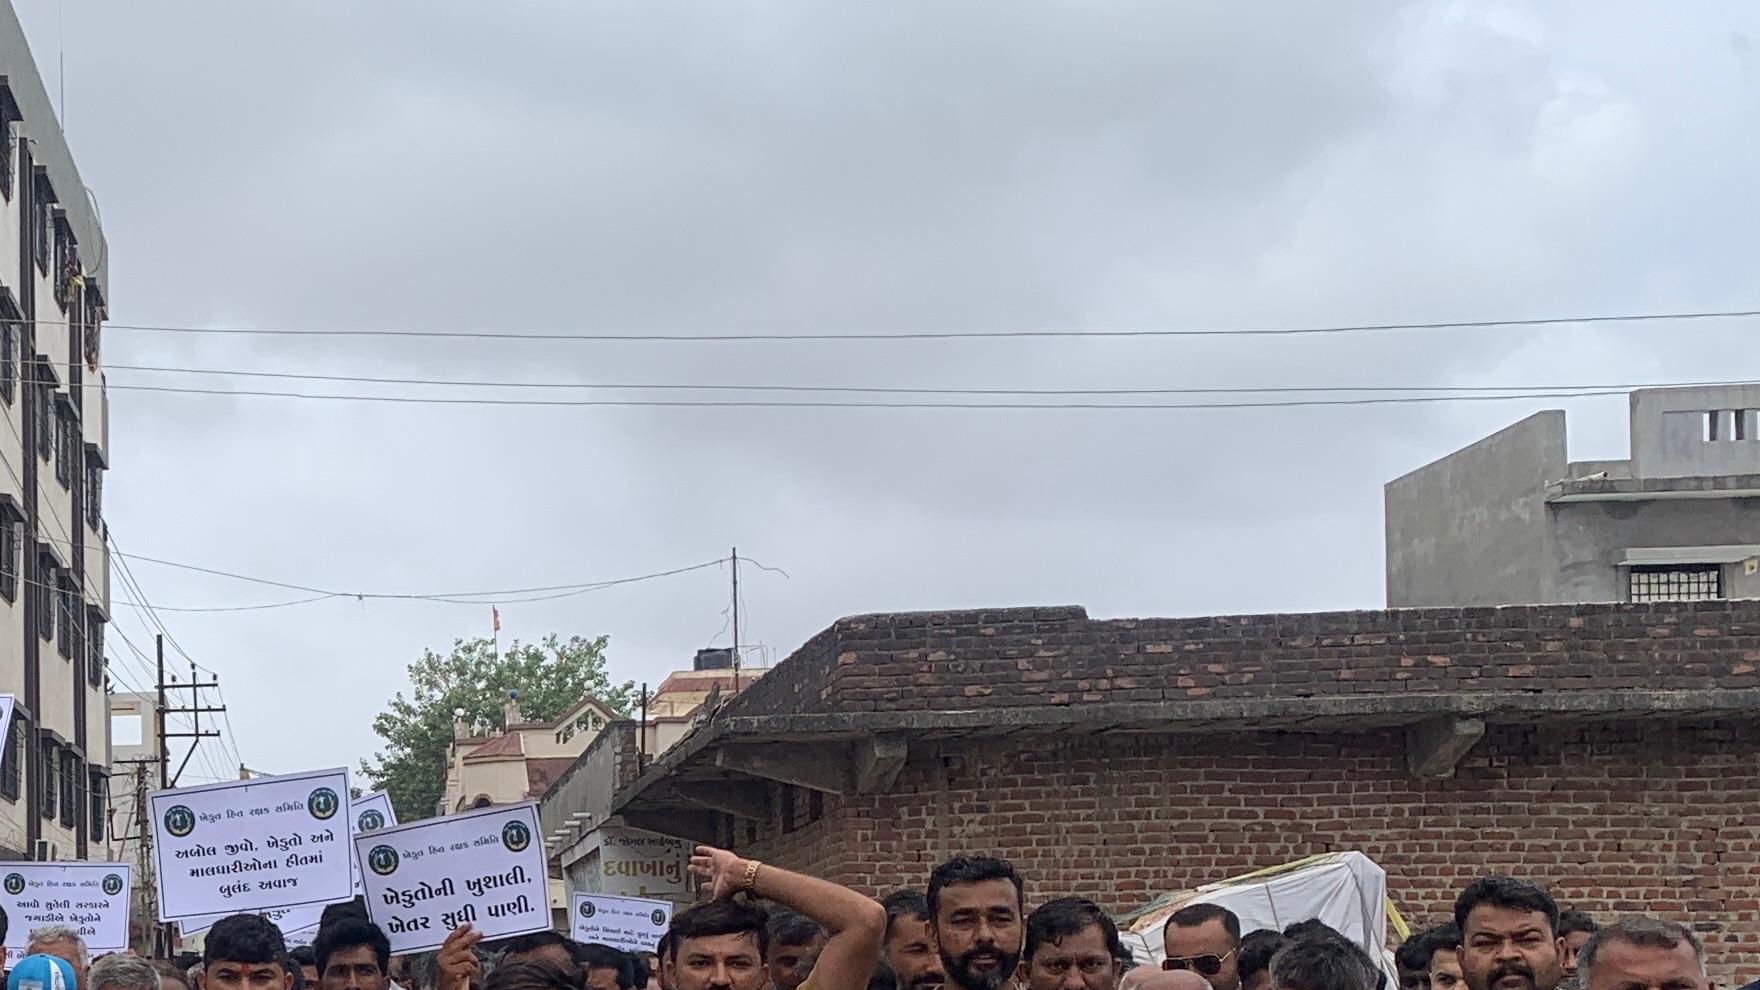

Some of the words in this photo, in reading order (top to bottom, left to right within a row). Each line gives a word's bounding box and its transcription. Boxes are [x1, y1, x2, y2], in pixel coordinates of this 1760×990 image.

[175, 842, 217, 859] અબોલ
[266, 832, 303, 852] ખેડુતો
[310, 829, 335, 843] અને
[189, 857, 278, 878] માલધારીઓના
[285, 850, 323, 868] હીતમાં
[603, 853, 682, 885] દવાખાનું
[219, 880, 251, 899] બુલંદ
[258, 877, 298, 890] અવાજ
[383, 877, 455, 909] ખેડુતોની
[387, 916, 431, 934] ખેતર
[441, 903, 477, 931] સુધી
[487, 895, 535, 919] પાણી.
